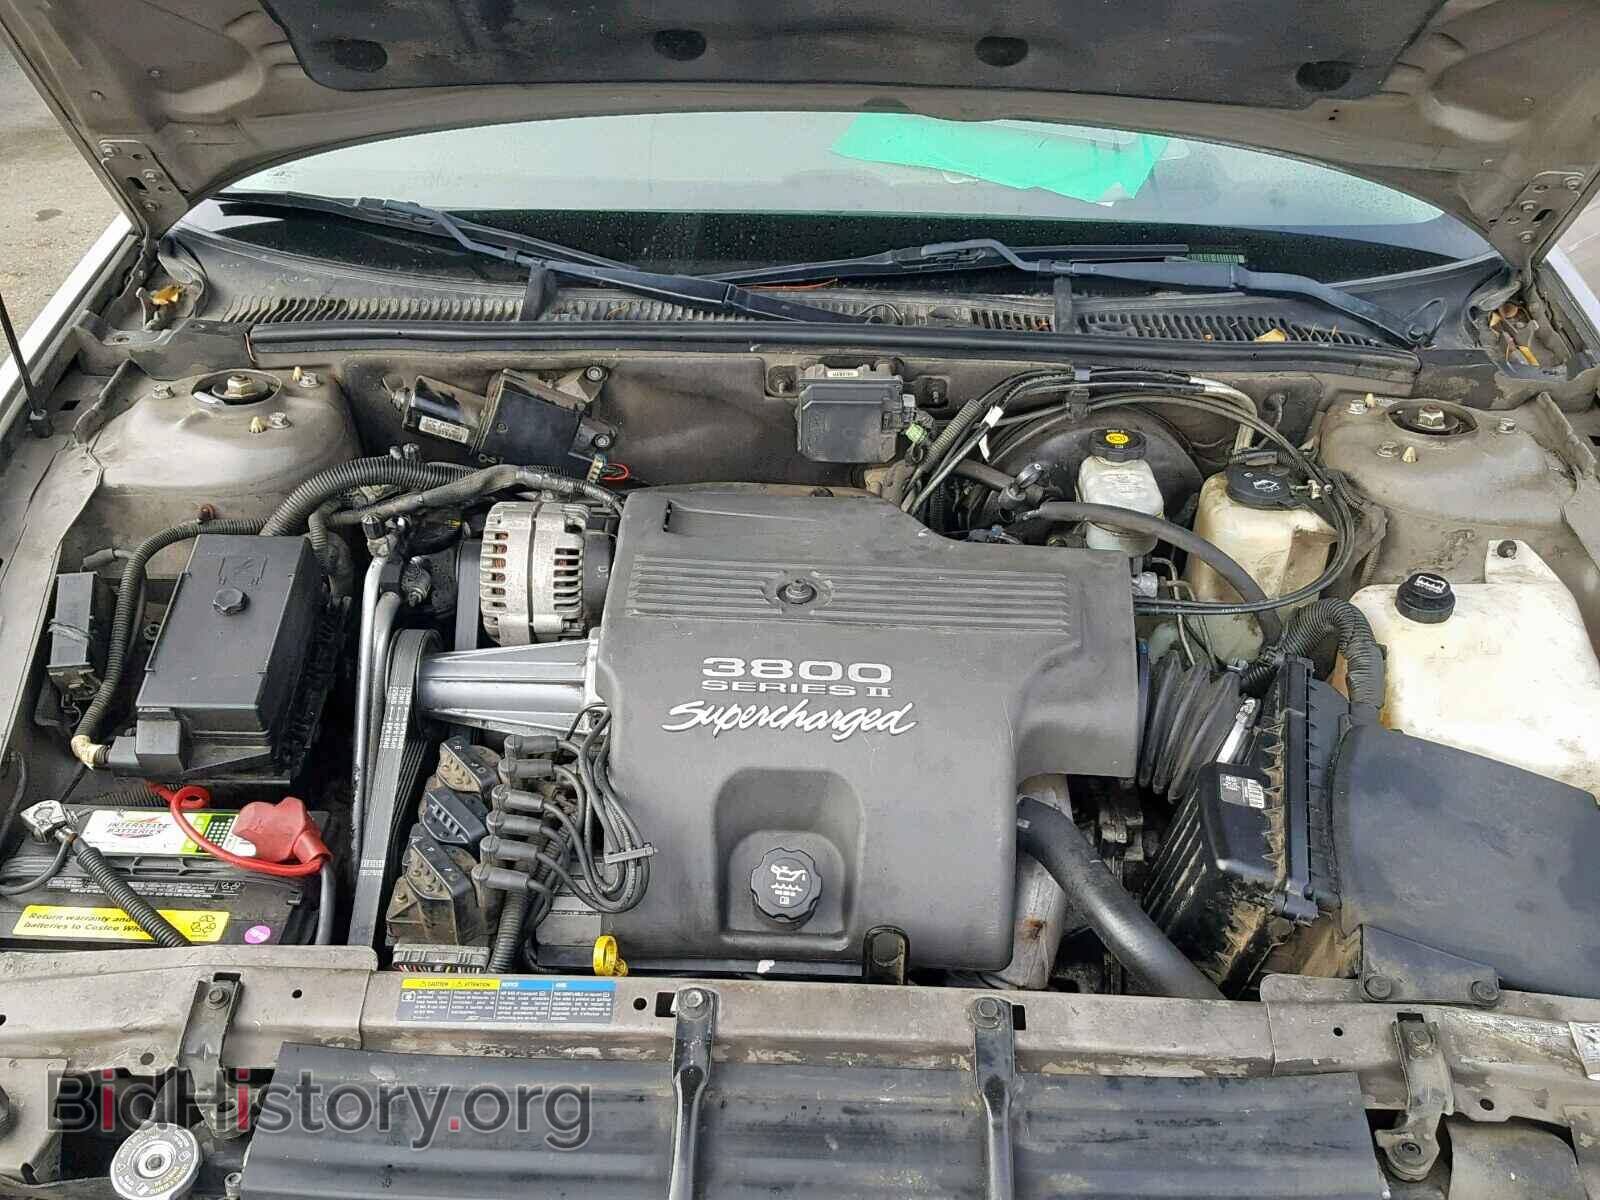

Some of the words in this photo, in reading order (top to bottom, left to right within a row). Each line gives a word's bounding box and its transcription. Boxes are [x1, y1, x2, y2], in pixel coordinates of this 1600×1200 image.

[702, 657, 892, 683] 3800
[701, 680, 857, 696] SERIES
[865, 686, 893, 698] II
[661, 699, 917, 742] Supercharged
[23, 921, 69, 930] batteries
[73, 923, 82, 931] to
[85, 923, 120, 932] Costco
[28, 912, 64, 921] Return
[66, 914, 111, 924] warranty
[112, 915, 132, 923] and
